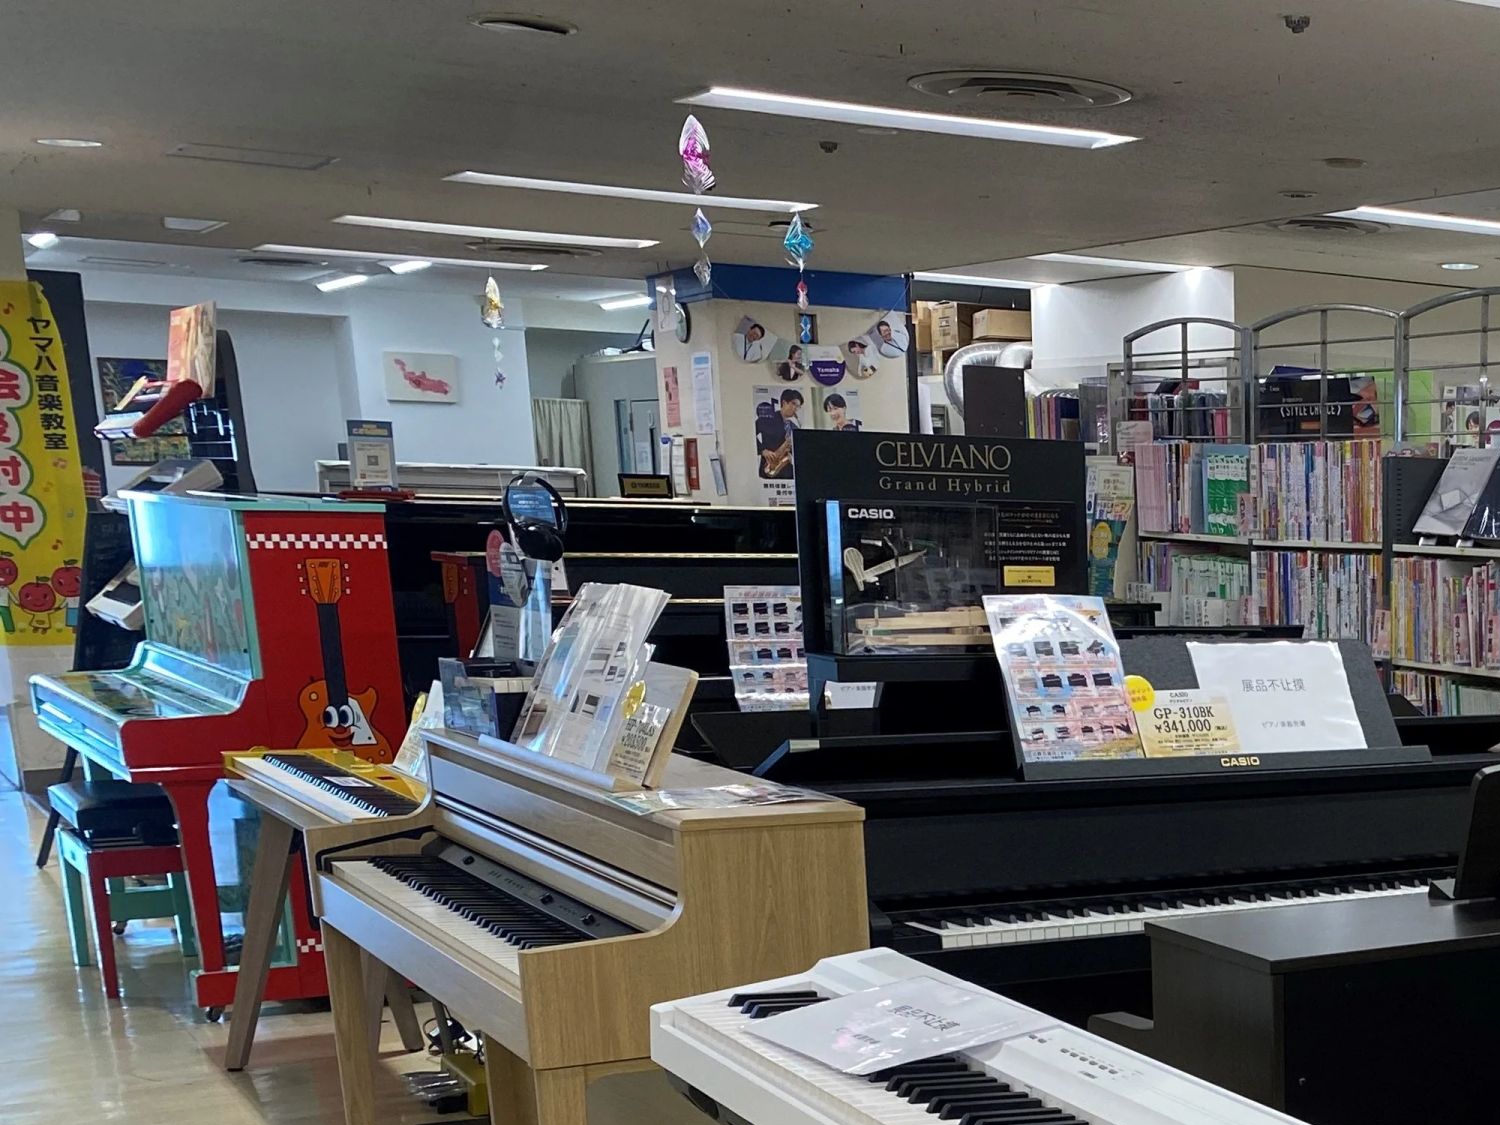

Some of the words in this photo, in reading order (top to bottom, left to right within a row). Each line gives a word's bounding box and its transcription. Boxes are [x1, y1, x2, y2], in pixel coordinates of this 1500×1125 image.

[27, 315, 69, 450] ヤマハ音楽教室
[875, 440, 1012, 471] CELVIANO
[879, 476, 937, 492] Grand
[948, 478, 1011, 495] Hybrid
[848, 507, 894, 520] CASIO
[1153, 706, 1214, 719] GP-310BK
[1154, 719, 1212, 733] ¥341,000
[1220, 756, 1260, 767] CASIO
